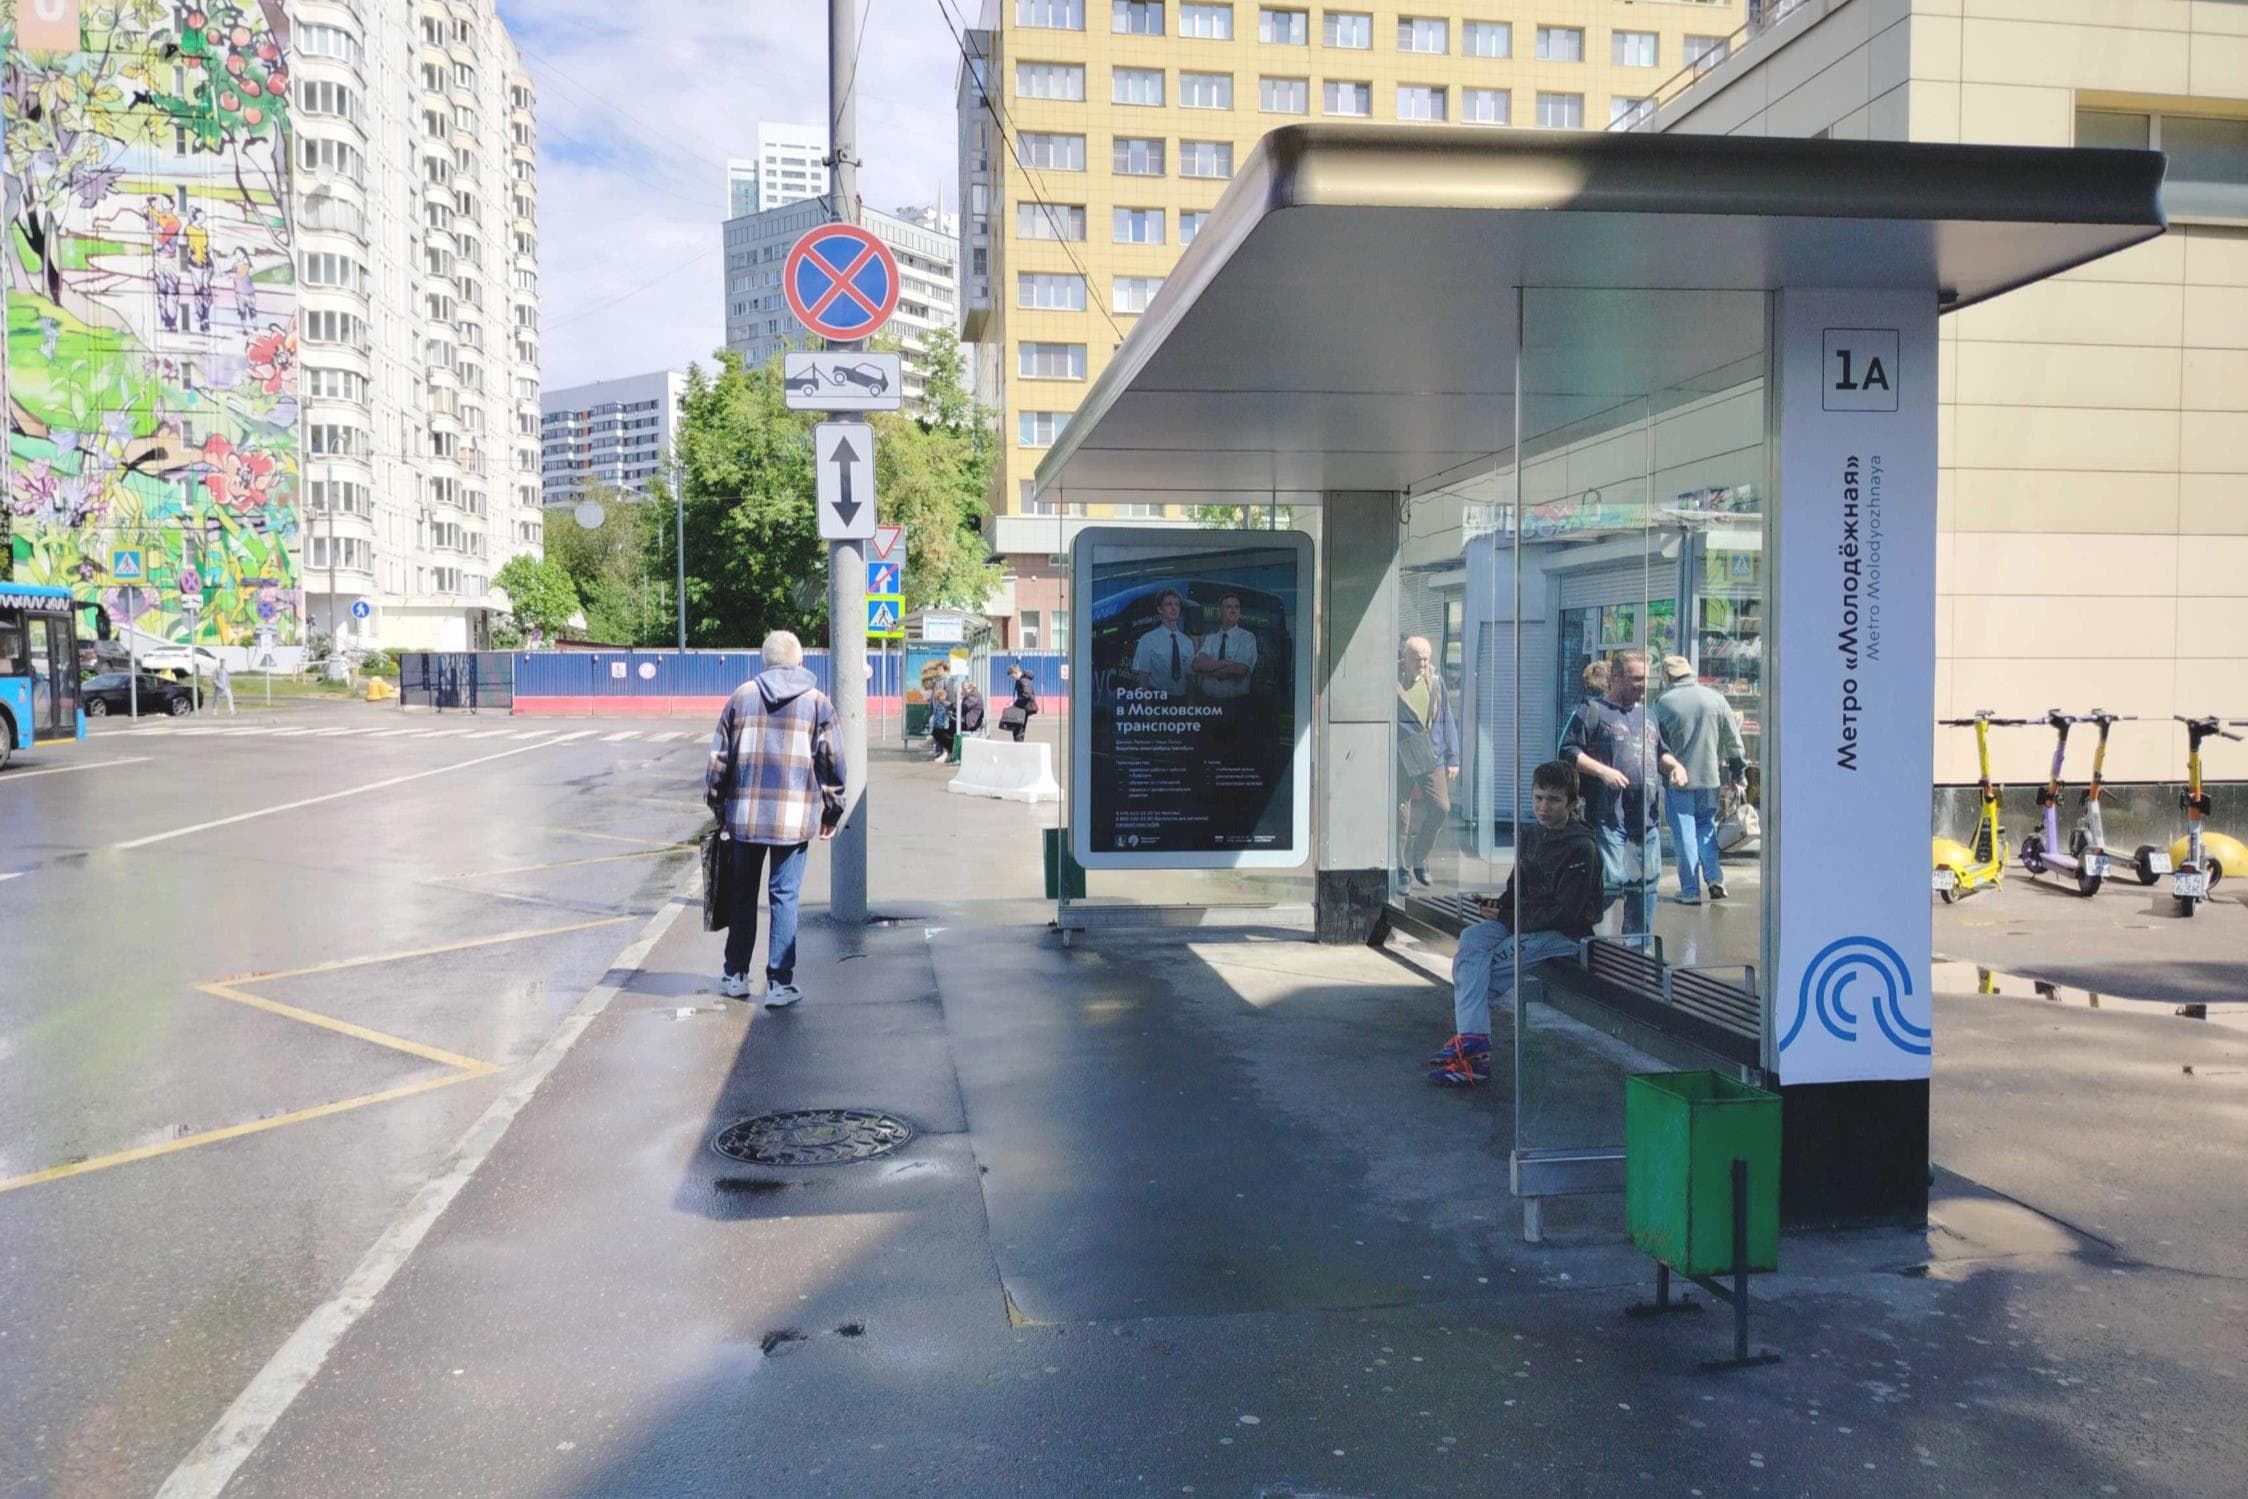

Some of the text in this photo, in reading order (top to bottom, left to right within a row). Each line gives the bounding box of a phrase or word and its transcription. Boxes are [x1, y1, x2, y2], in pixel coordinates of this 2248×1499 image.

[1867, 454, 1884, 661] Metro Molodyozhnaya
[1837, 455, 1863, 771] Метро «Молодёжная»
[1116, 687, 1168, 700] Работа
[1116, 703, 1223, 716] в Московском
[1116, 721, 1202, 735] транспорте
